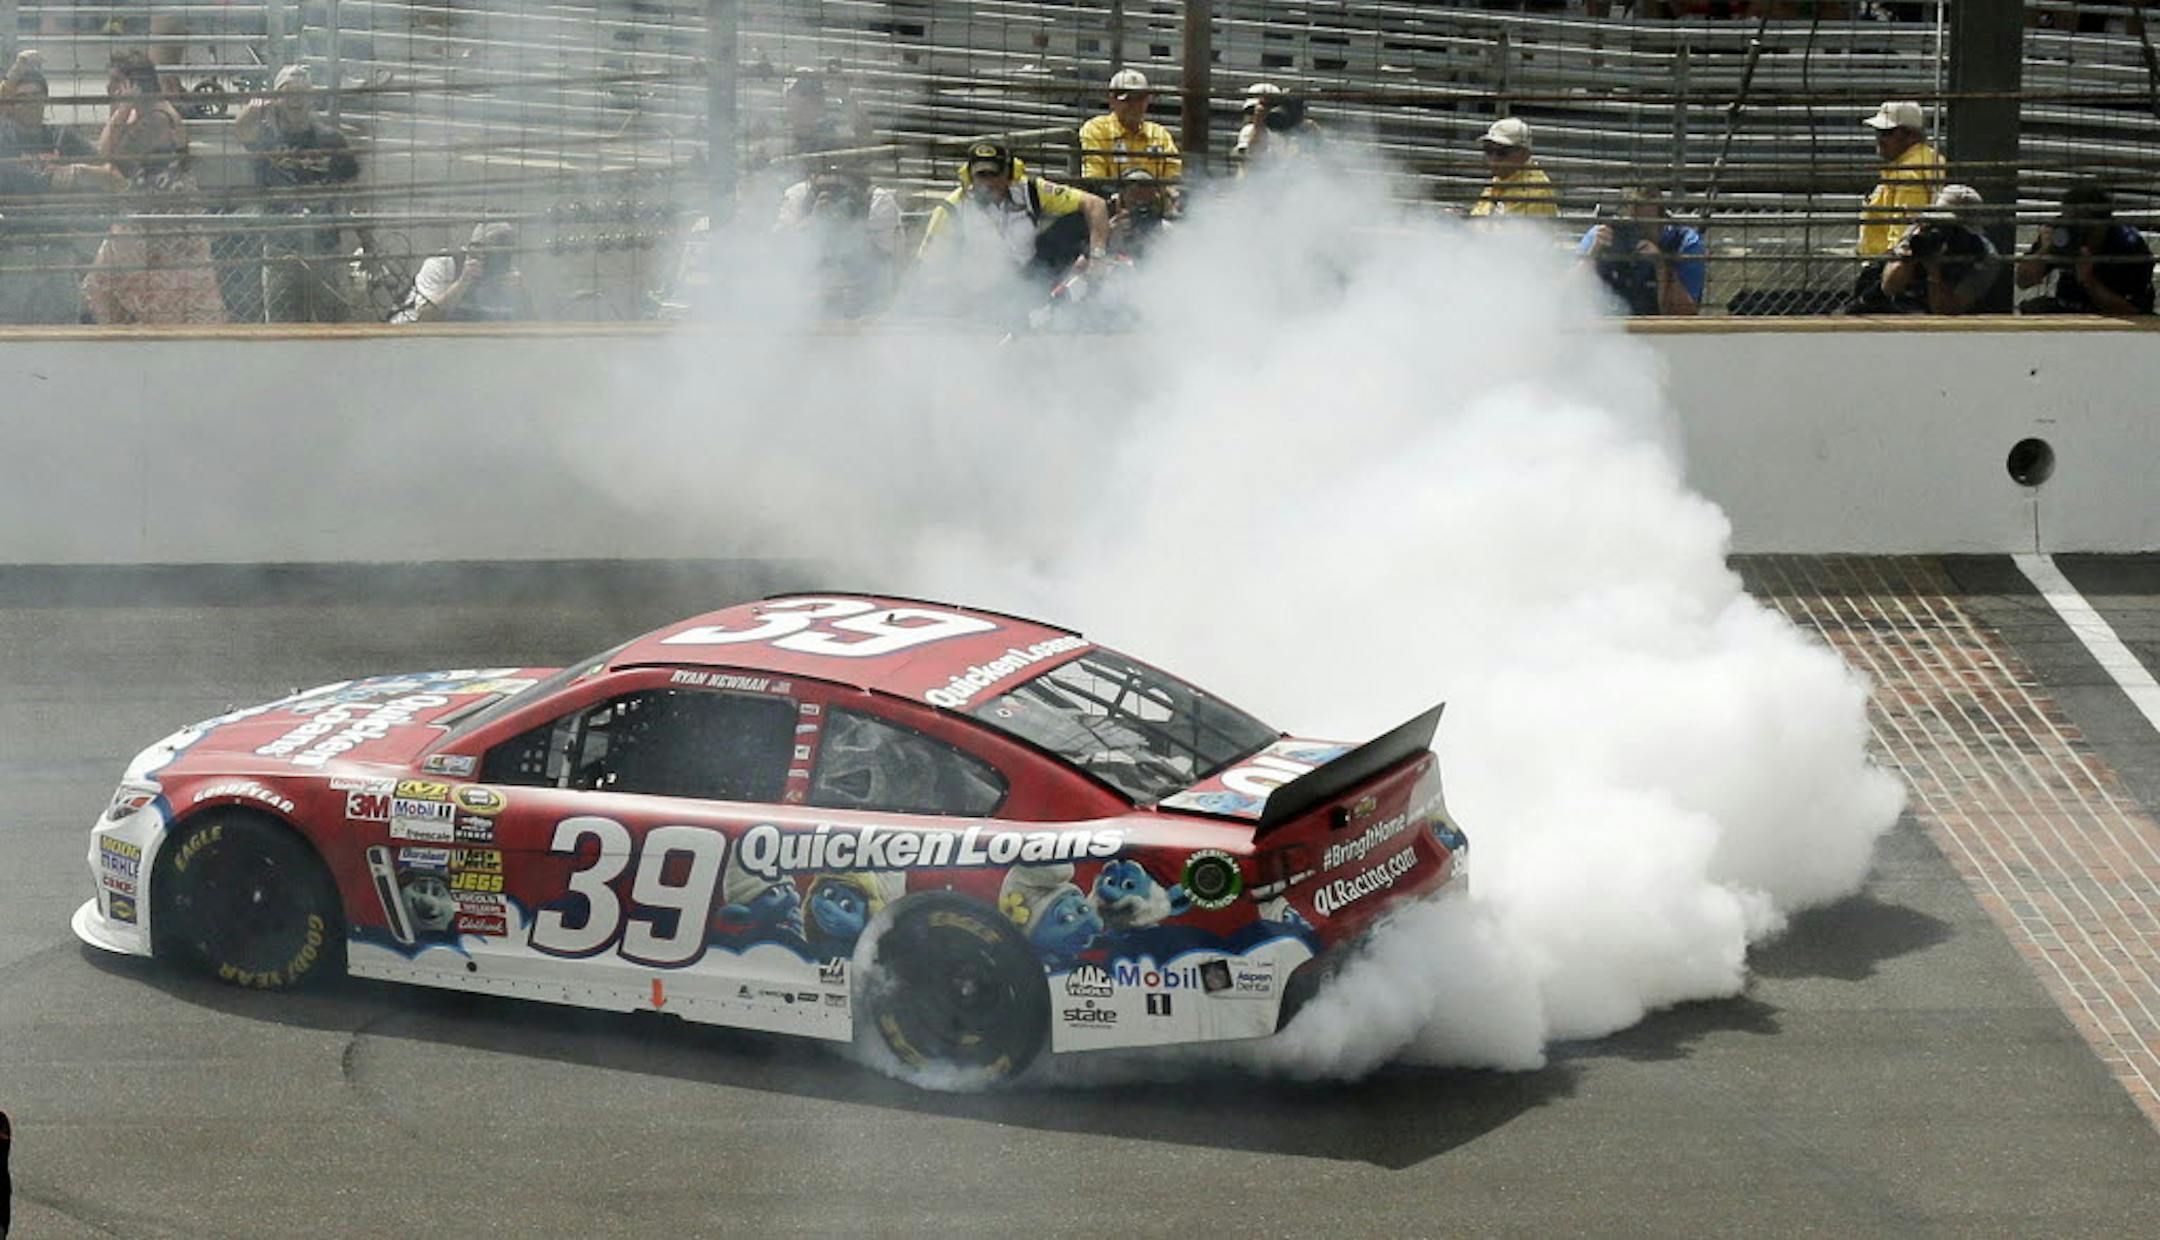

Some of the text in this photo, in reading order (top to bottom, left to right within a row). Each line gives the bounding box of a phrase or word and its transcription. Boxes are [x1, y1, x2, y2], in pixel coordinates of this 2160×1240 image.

[660, 598, 998, 657] 39
[671, 669, 769, 691] RYAN NEWMAN
[193, 781, 295, 814] GOODYEAR
[350, 793, 390, 818] 3M
[395, 801, 435, 817] Mobil
[174, 825, 223, 872] EAGLE
[1322, 813, 1406, 872] #BringItHome
[450, 872, 504, 892] JEGS
[530, 815, 727, 967] 39
[1314, 845, 1418, 917] QLRacing.com
[1068, 965, 1111, 987] MAC
[1118, 965, 1198, 989] Mobil
[1238, 970, 1272, 982] Aspen
[1069, 986, 1113, 997] TOOLS
[1063, 1008, 1118, 1023] state
